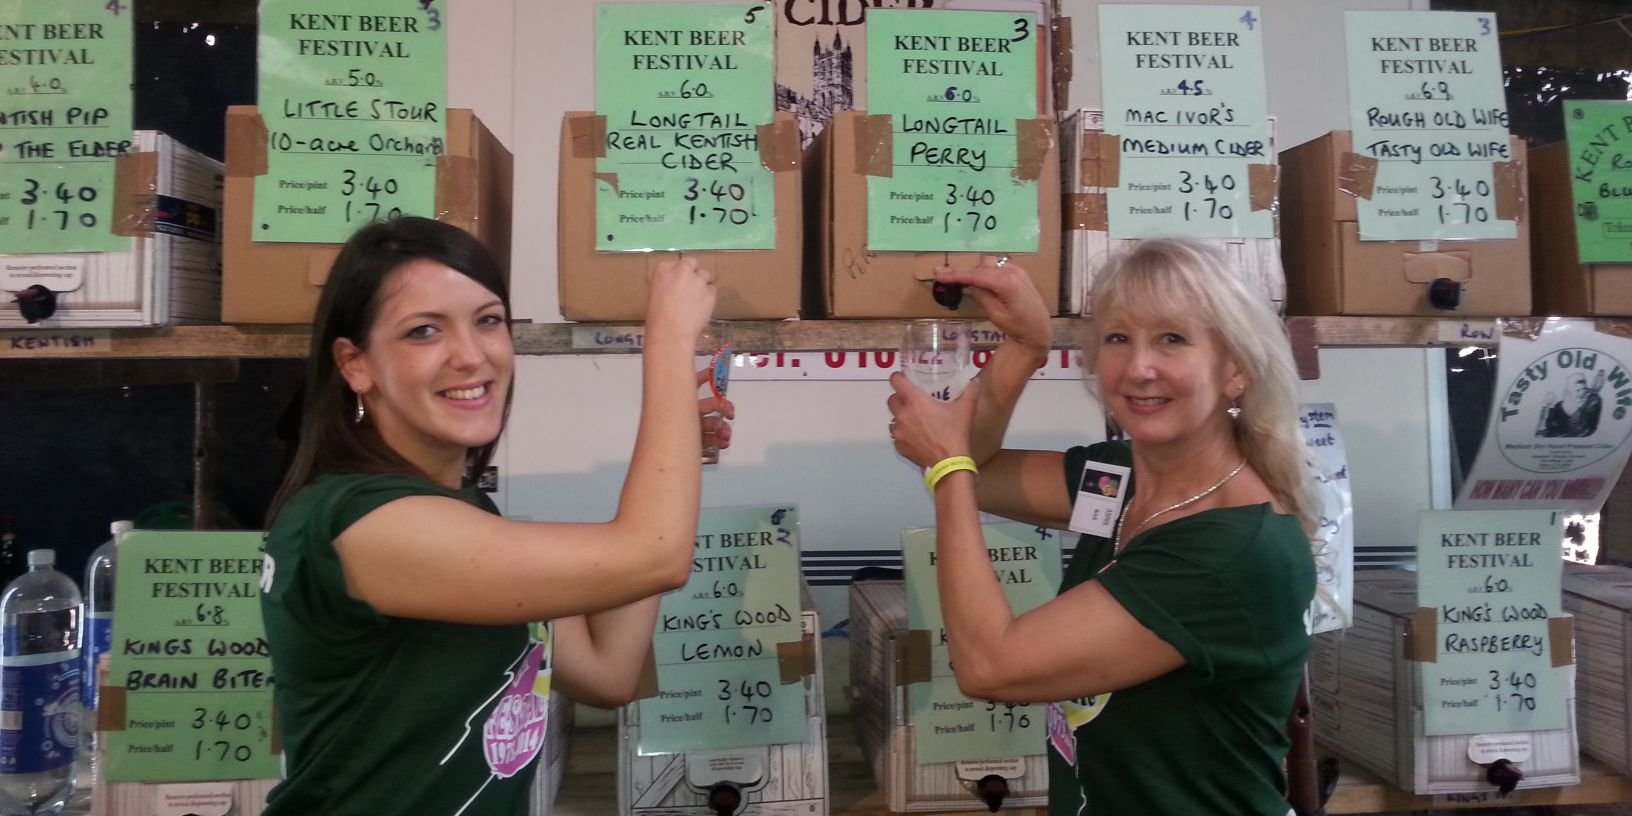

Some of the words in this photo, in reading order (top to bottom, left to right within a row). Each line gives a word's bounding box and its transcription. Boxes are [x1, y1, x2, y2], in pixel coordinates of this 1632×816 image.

[427, 8, 441, 31] 3
[744, 6, 765, 24] 5
[784, 0, 933, 26] CID
[43, 24, 104, 40] BEER
[290, 14, 352, 31] KENT
[359, 15, 419, 33] BEER
[1010, 18, 1030, 42] 3
[1477, 17, 1491, 36] 3
[624, 31, 683, 46] KENT
[689, 31, 746, 46] BEER
[894, 35, 951, 51] KENT
[958, 37, 1012, 53] BEER
[1127, 31, 1181, 46] KENT
[1188, 32, 1240, 47] BEER
[1371, 37, 1424, 51] KENT
[1429, 38, 1478, 52] BEER
[299, 39, 410, 58] FESTIVAL
[633, 54, 738, 70] FESTIVAL
[903, 58, 1003, 77] FESTIVAL
[1136, 54, 1233, 69] FESTIVAL
[1380, 59, 1473, 74] FESTIVAL
[67, 107, 109, 126] PIP
[284, 99, 358, 118] LITTLE
[371, 99, 438, 123] STOUR
[631, 110, 748, 129] LONGTAIL
[1125, 108, 1168, 124] MAC
[1176, 102, 1234, 126] IVOR'S
[1367, 107, 1426, 128] ROUGH
[1433, 110, 1466, 128] OLD
[1472, 108, 1510, 128] WIFE
[903, 114, 1008, 134] LONGTAIL
[13, 141, 55, 159] THE
[607, 131, 661, 150] REAL
[675, 133, 758, 151] KENTISH
[1122, 138, 1208, 156] MEDIUM
[911, 142, 986, 171] PERRY
[1366, 140, 1422, 165] TASTY
[1430, 143, 1461, 157] OLD
[1468, 142, 1509, 158] WIFE
[1576, 124, 1619, 183] KENT
[661, 152, 738, 173] CIDER
[279, 180, 328, 191] Price/pint
[619, 190, 665, 199] Price/pint
[1128, 183, 1171, 193] Price/pint
[890, 191, 934, 202] Price/pint
[277, 205, 328, 214] Price/half
[890, 215, 934, 225] Price/half
[11, 336, 95, 350] KENTISH
[1501, 361, 1548, 423] Tasty
[1557, 350, 1597, 370] Old
[1607, 365, 1632, 420] Wife
[720, 532, 773, 548] BEER
[1441, 533, 1489, 548] KENT
[1494, 532, 1541, 546] BEER
[987, 546, 1038, 562] BEER
[1448, 554, 1534, 569] FESTIVAL
[144, 558, 205, 574] KENT
[208, 558, 264, 574] BEER
[693, 555, 766, 573] STIVAL
[152, 583, 256, 598] FESTIVAL
[663, 610, 723, 631] KING'S
[735, 604, 792, 626] WOOD
[1442, 603, 1492, 623] KING'S
[1503, 603, 1548, 622] WOOD
[123, 638, 192, 656] KINGS
[208, 637, 272, 657] WOOD
[682, 639, 763, 662] LEMON
[1445, 633, 1544, 657] RASPBERRY
[126, 670, 197, 691] BRAIN
[659, 689, 702, 700] Price/pint
[934, 724, 975, 735] Price/half
